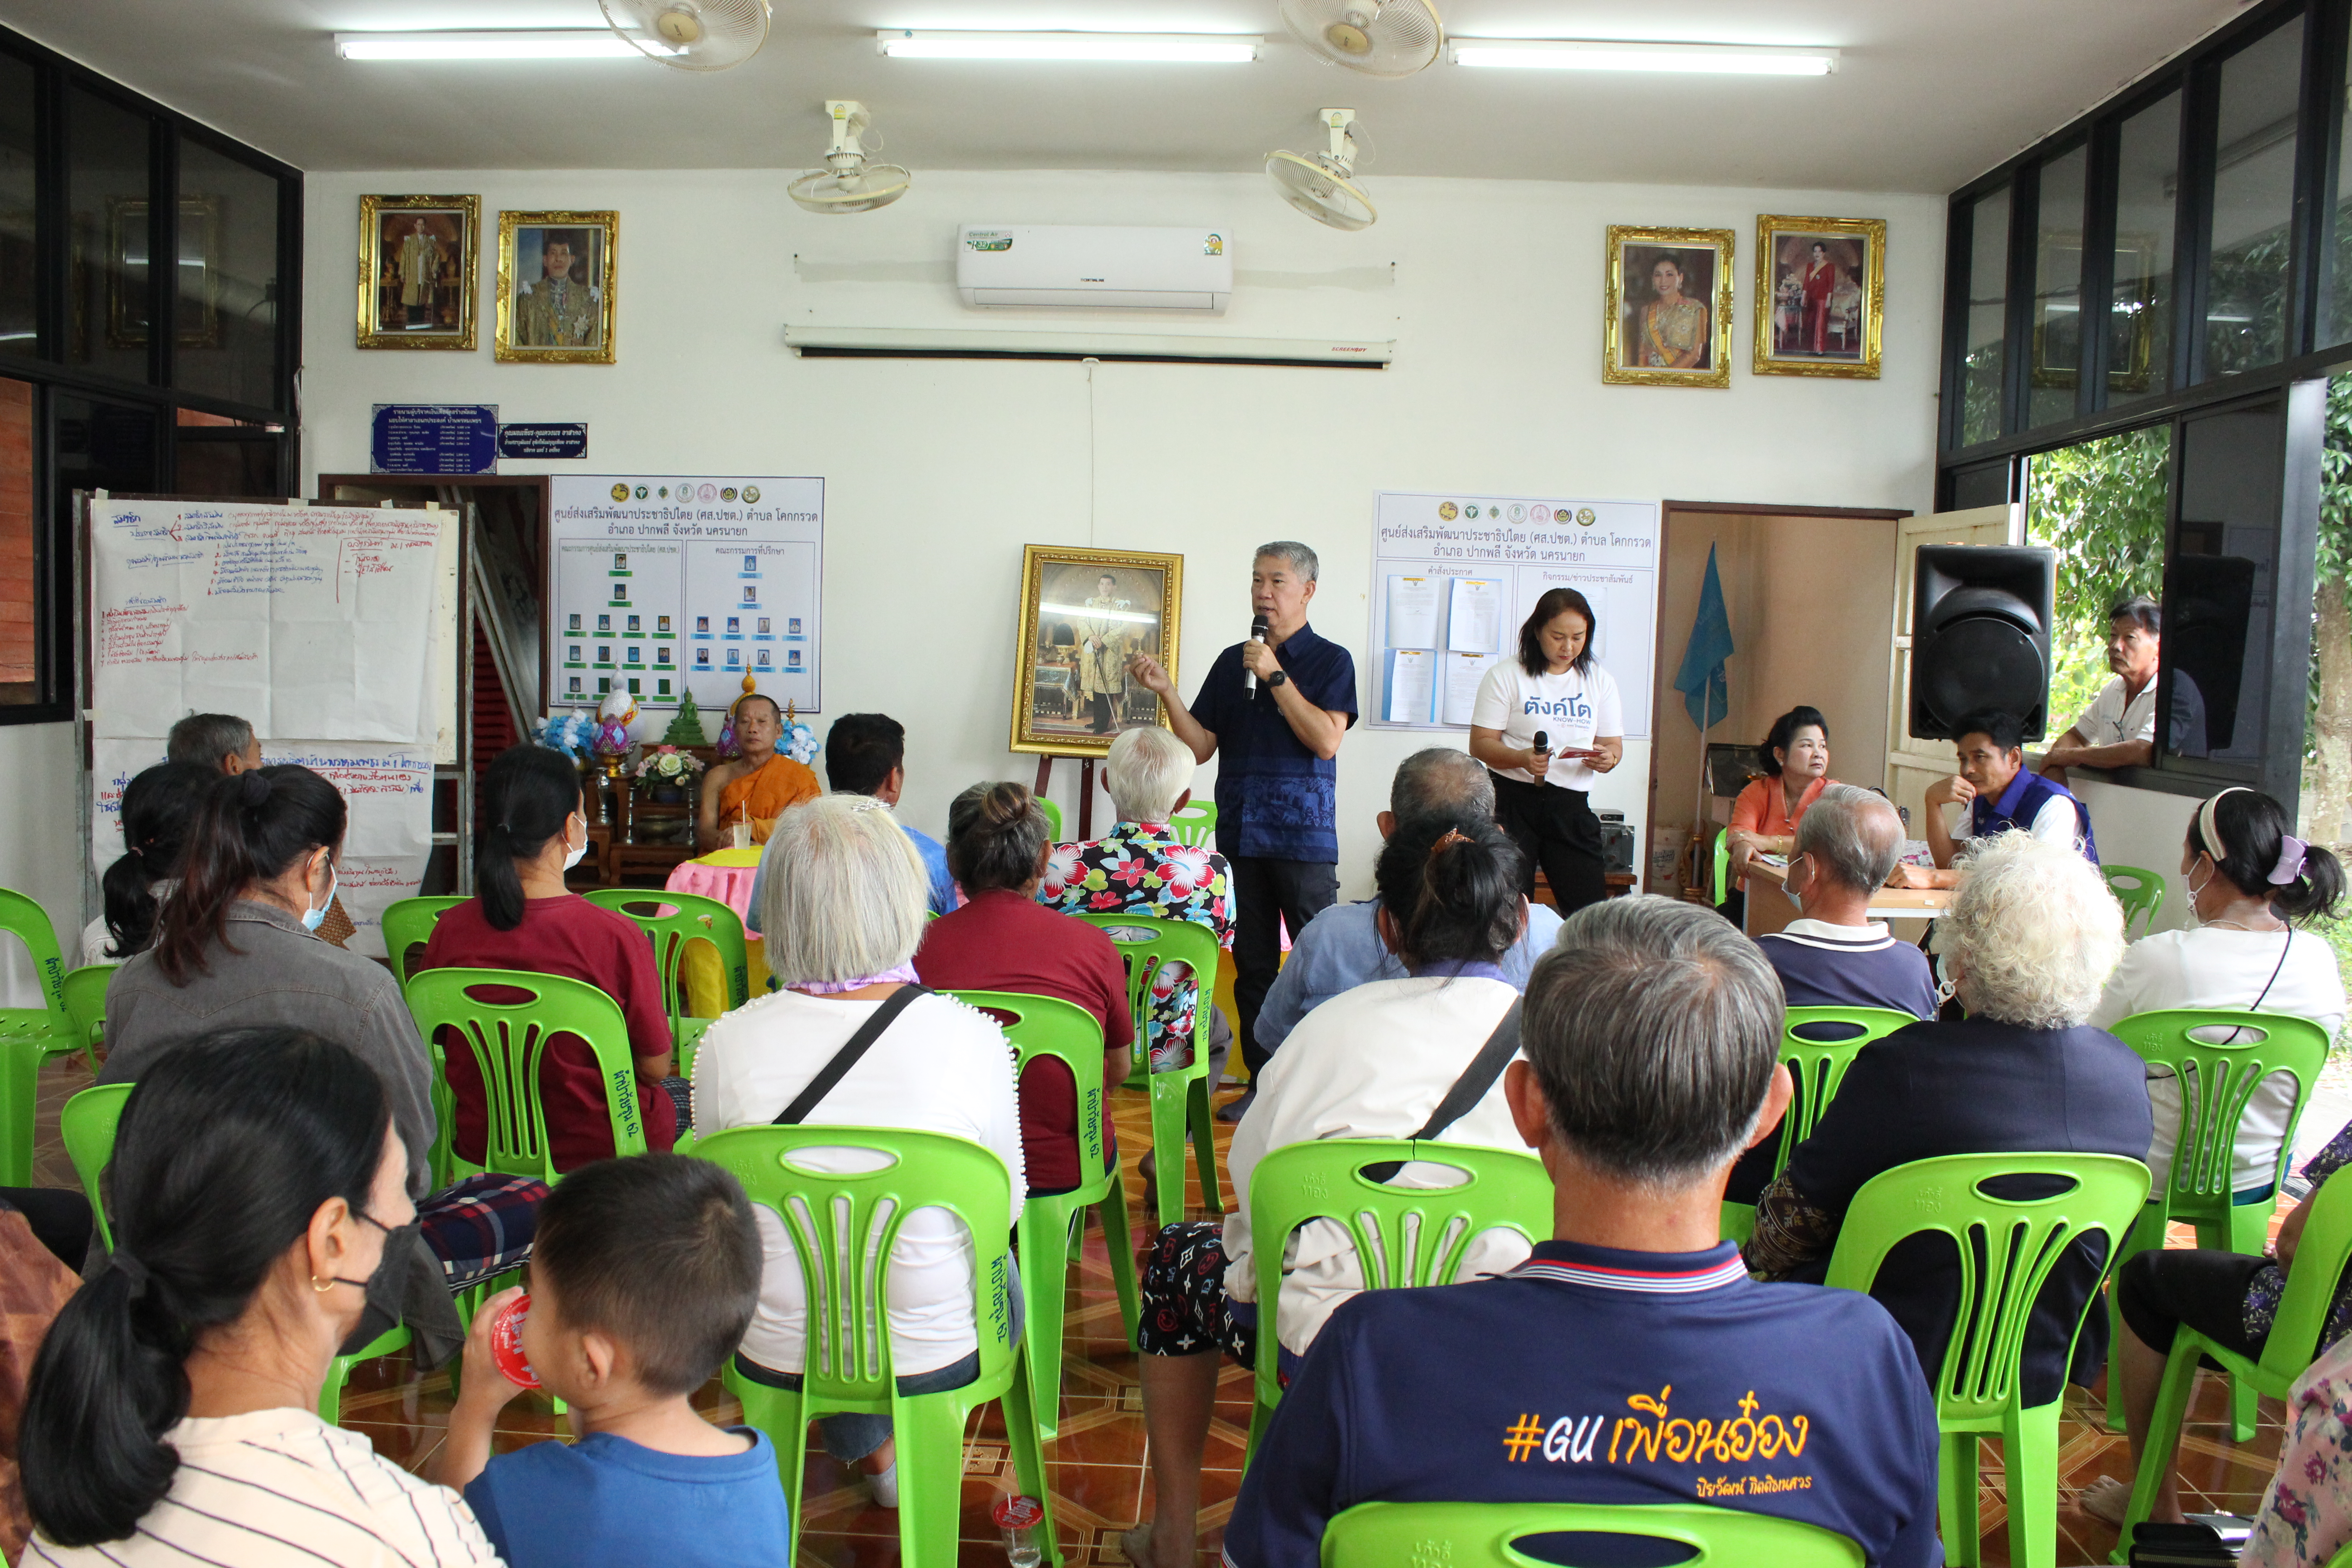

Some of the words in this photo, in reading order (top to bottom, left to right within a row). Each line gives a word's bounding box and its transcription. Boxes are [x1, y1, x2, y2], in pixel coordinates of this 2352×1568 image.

[554, 505, 692, 523] ศูนย์ส่งเสริมพัฒนาประชาธิปไตย
[696, 509, 743, 521] (ศส.ปชต.)
[746, 508, 772, 521] ตำบล
[775, 508, 818, 522] โคกกรวด
[608, 522, 634, 534] อำเภอ
[637, 523, 669, 535] ปากพลี
[672, 523, 702, 536] จังหวัด
[706, 526, 748, 536] นครนายก
[1381, 524, 1526, 544] ศูนย์ส่งเสริมพัฒนาประชาธิปไตย
[1529, 531, 1577, 546] (ศส.ปชต.)
[1581, 530, 1607, 546] ตำบล
[1609, 531, 1651, 548] โคกกรวด
[715, 544, 785, 555] คณะกรรมการที่ปรึกษา
[1433, 543, 1462, 557] อำเภอ
[1467, 544, 1501, 558] ปากพลี
[1504, 544, 1537, 560] จังหวัด
[1540, 549, 1586, 562] นครนายก
[1427, 564, 1473, 577] คำสั่งประกาศ
[1542, 571, 1633, 584] กิจกรรม/ข่าวประชาสัมพันธ์
[1524, 692, 1592, 719] ตังค์โต
[1553, 716, 1592, 725] KNOW-HOW
[1202, 1030, 1208, 1042] 62
[613, 1069, 634, 1122] ผ้าป่าวัยรุ่น
[627, 1122, 639, 1138] 62
[1083, 1087, 1101, 1143] ผ้าป่าวัยรุ่น
[1090, 1143, 1100, 1160] 62
[988, 1254, 1008, 1323] ผ้าป่าวัยรุ่น
[996, 1322, 1008, 1344] 62
[1503, 1413, 1604, 1463] #GU
[1607, 1384, 1808, 1465] เพื่อนอ๋อง
[1697, 1475, 1747, 1498] ปิยวัฒน์
